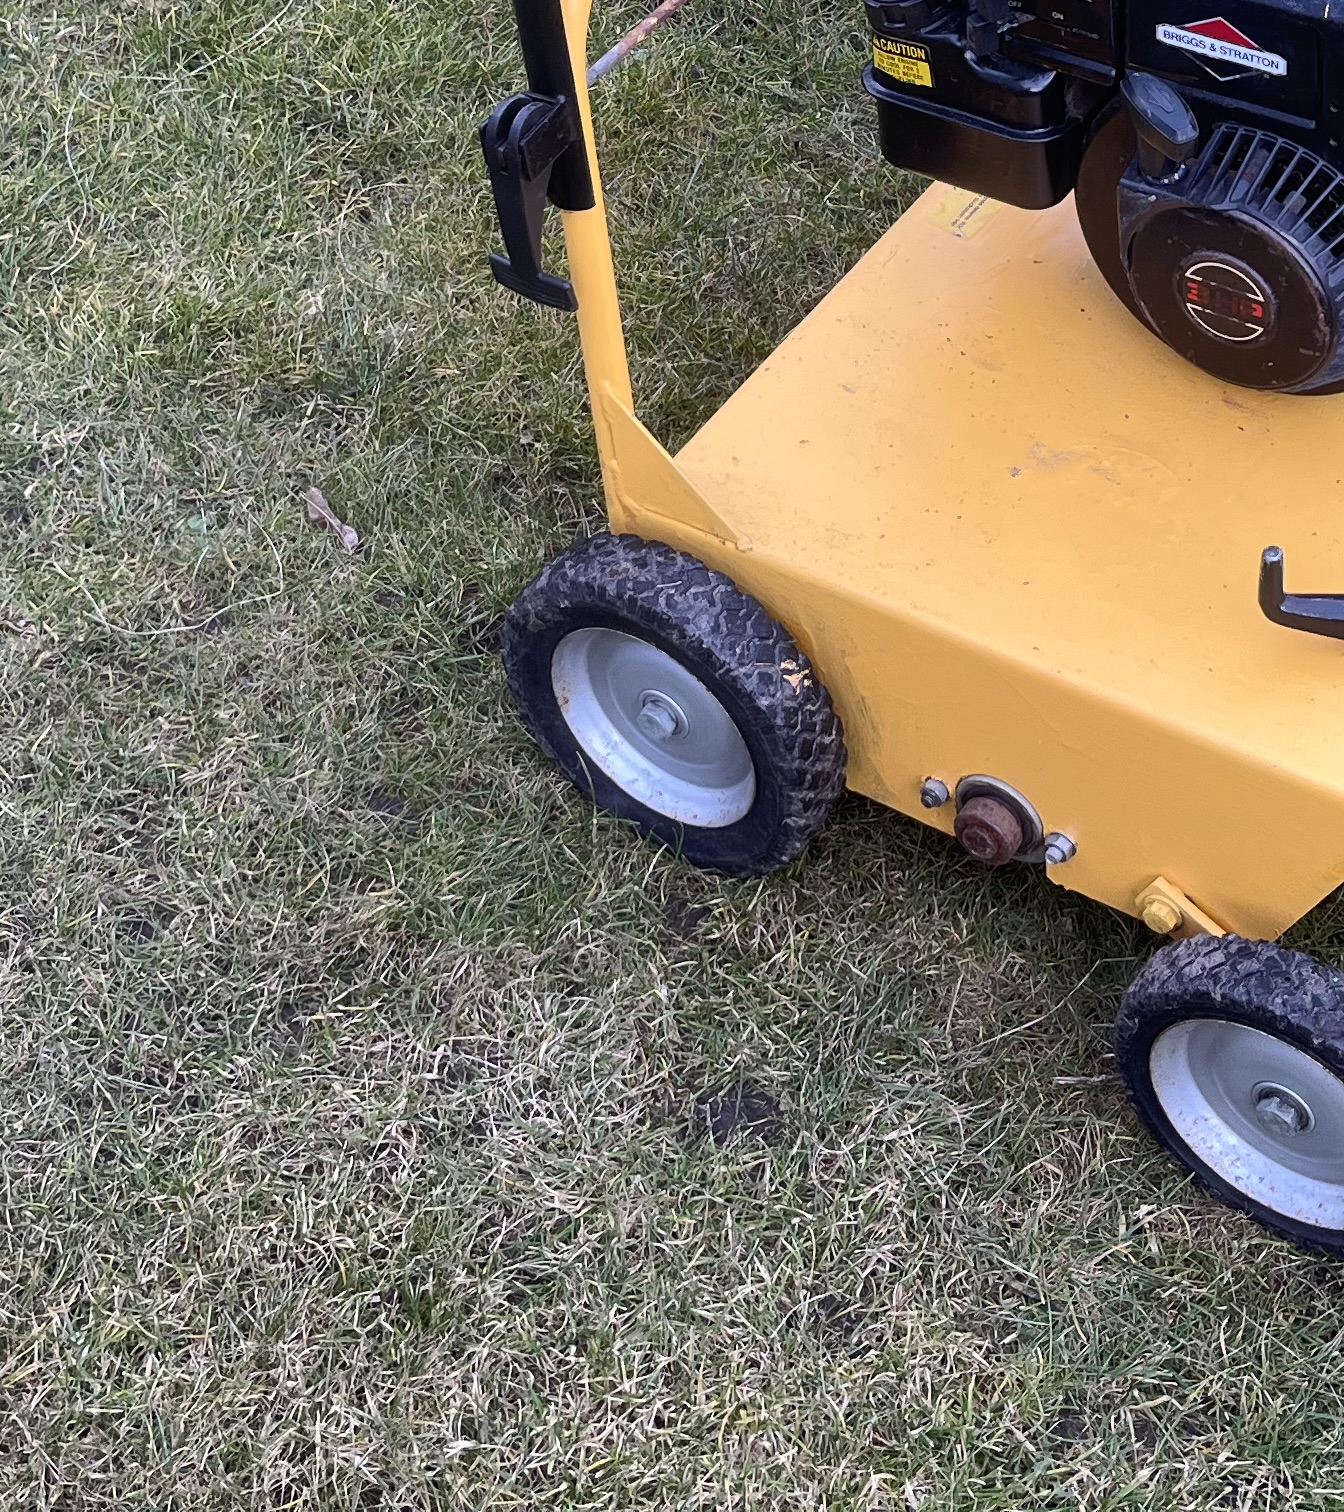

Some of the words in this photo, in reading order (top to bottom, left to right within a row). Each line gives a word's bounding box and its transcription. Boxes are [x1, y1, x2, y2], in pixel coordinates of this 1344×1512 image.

[1052, 11, 1064, 20] ON
[879, 38, 926, 60] CAUTION
[1163, 30, 1206, 49] BRIGGS
[1209, 43, 1217, 51] &
[1220, 46, 1279, 70] STRATTON
